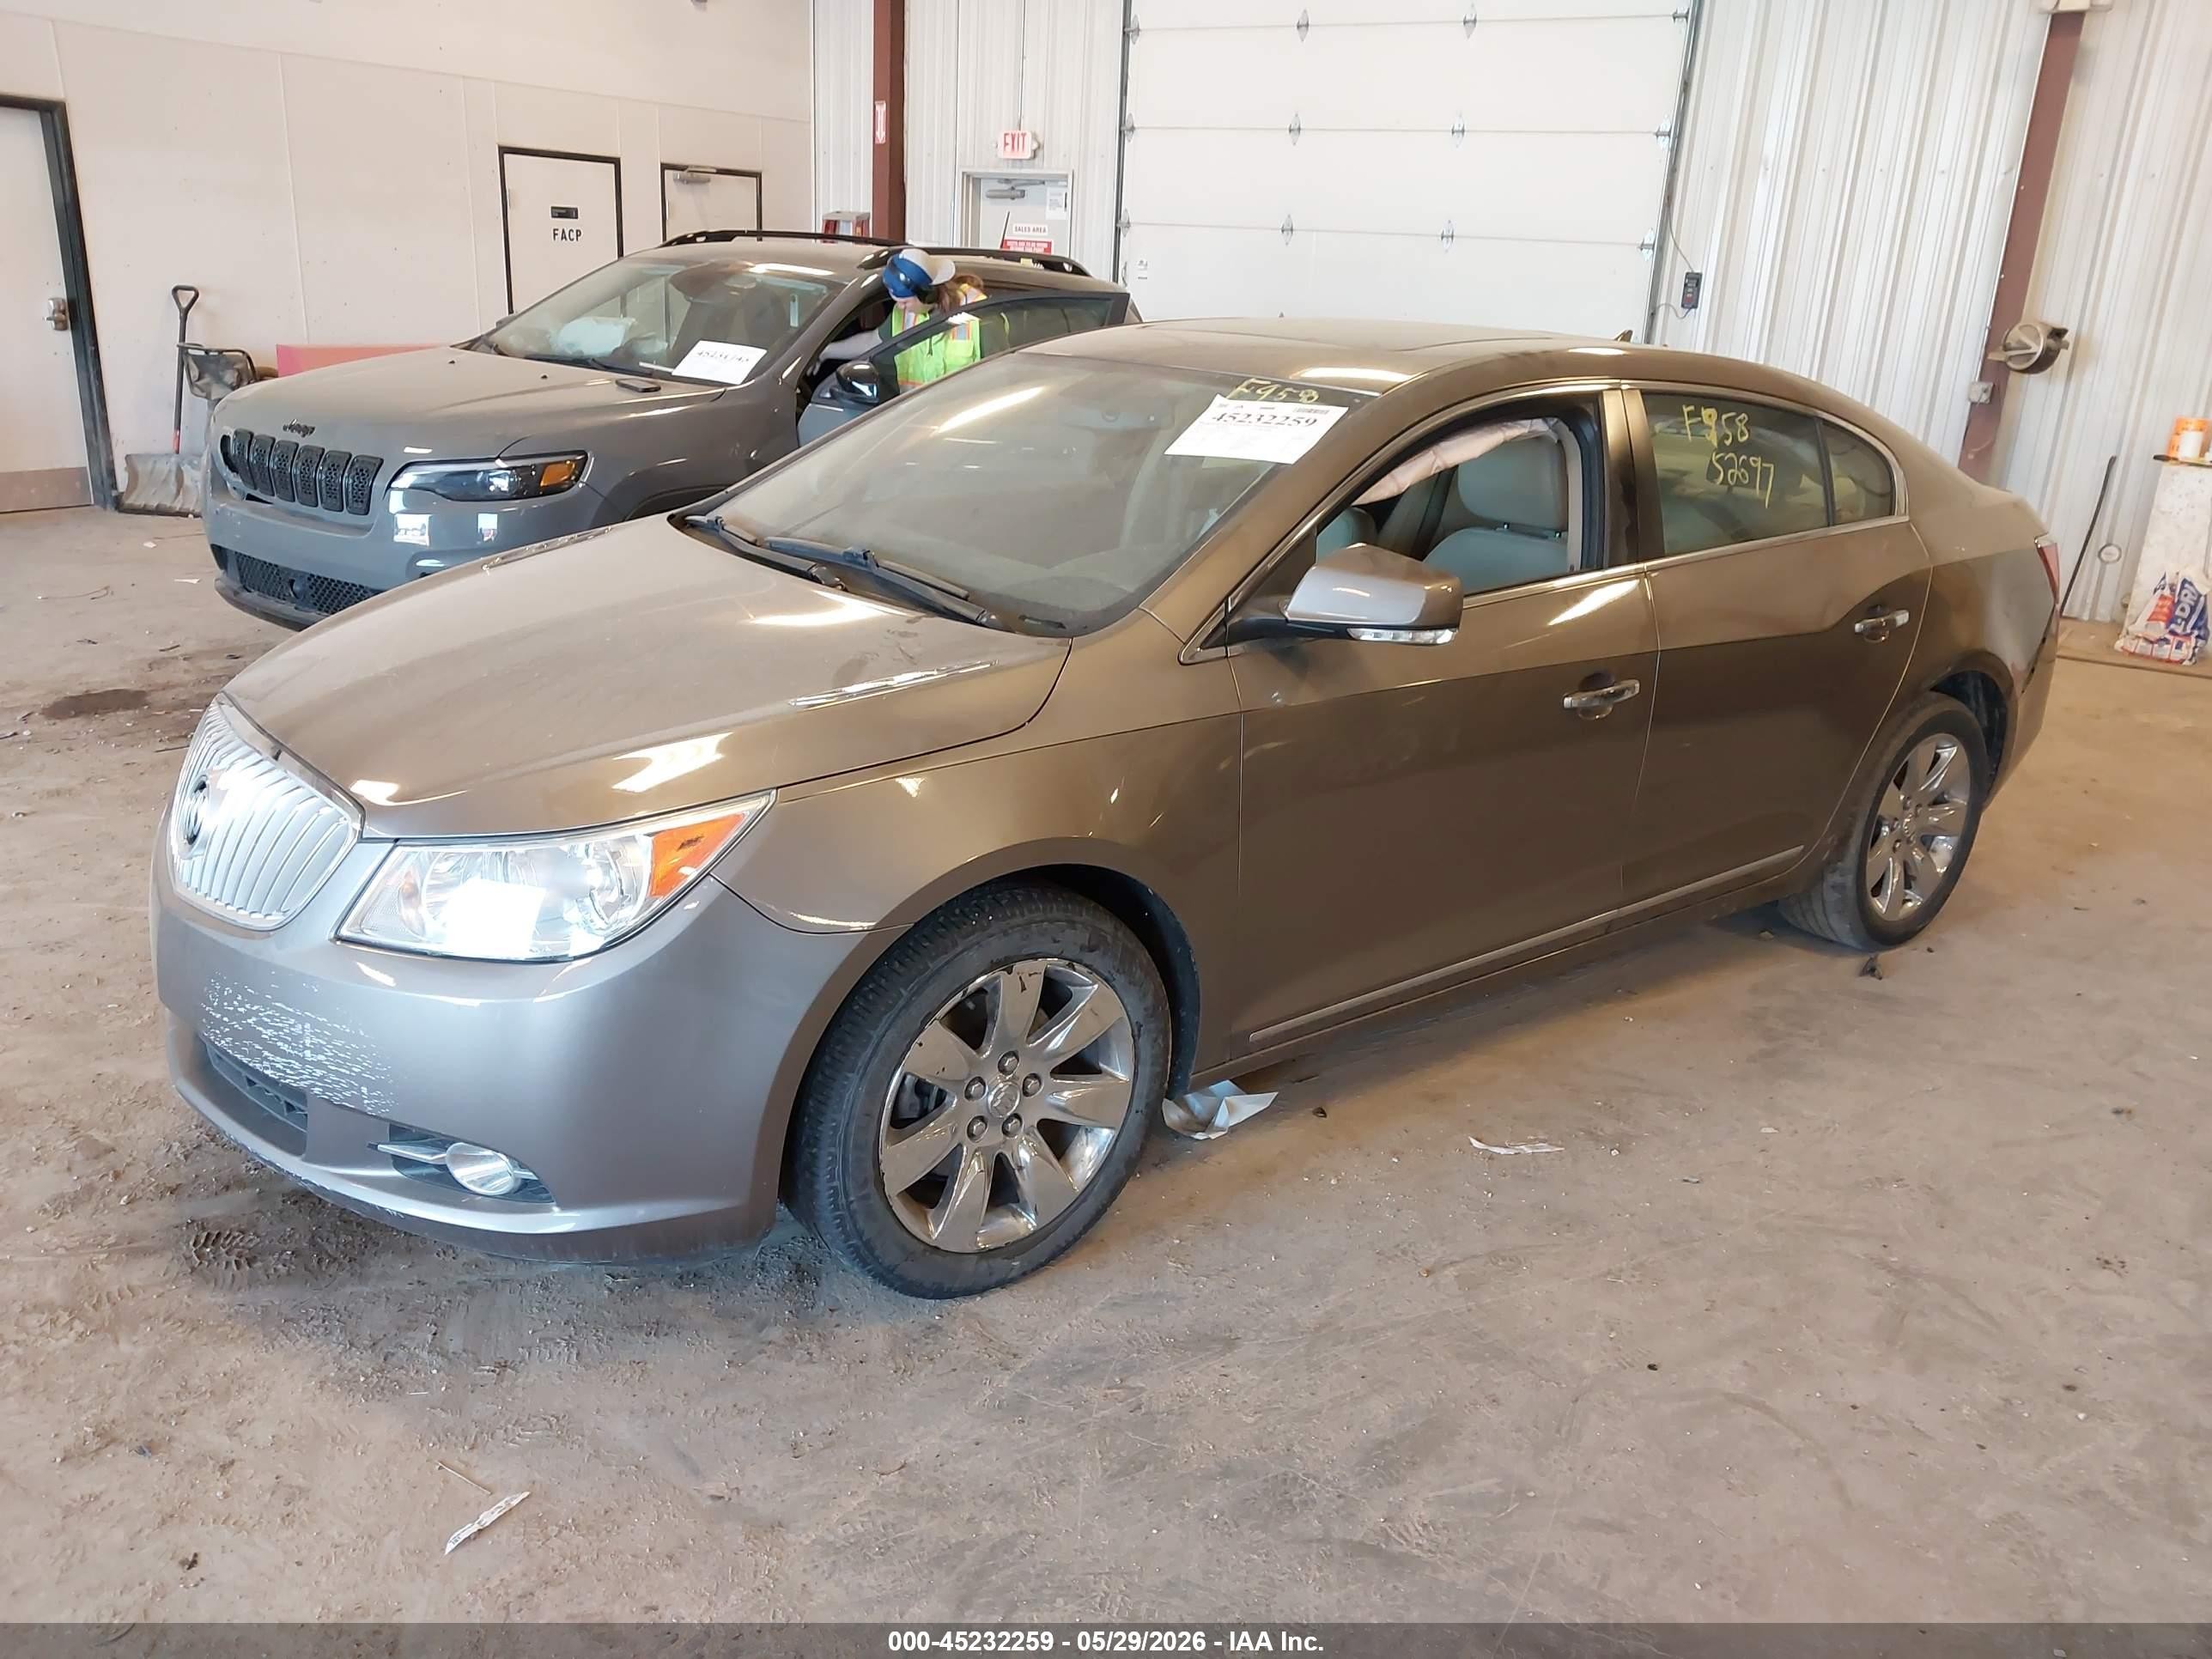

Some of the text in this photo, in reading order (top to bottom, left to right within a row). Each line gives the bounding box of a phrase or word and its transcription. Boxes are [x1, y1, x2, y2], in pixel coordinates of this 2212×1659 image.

[1003, 131, 1027, 152] EXIT
[552, 228, 582, 241] FACP
[1225, 377, 1320, 404] F958
[1212, 412, 1318, 428] 45232259
[1712, 451, 1775, 508] 52697
